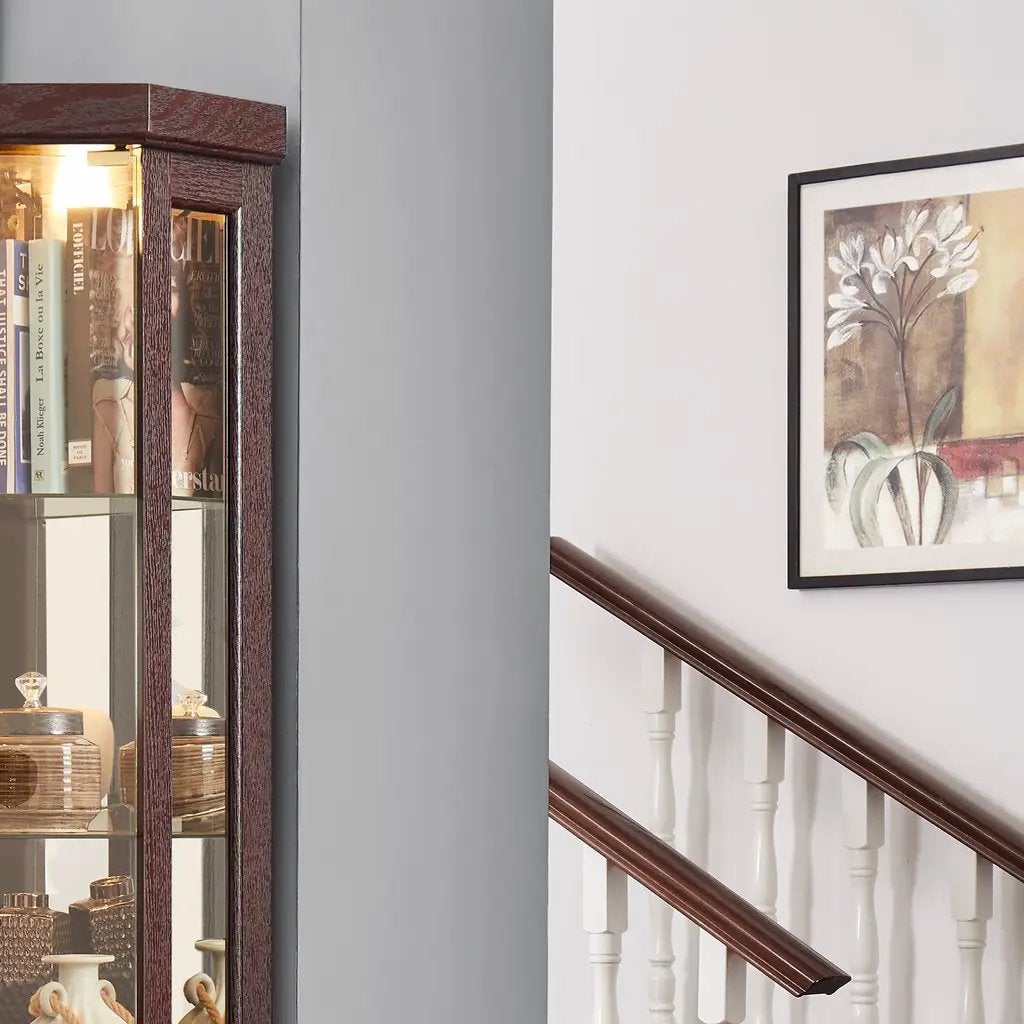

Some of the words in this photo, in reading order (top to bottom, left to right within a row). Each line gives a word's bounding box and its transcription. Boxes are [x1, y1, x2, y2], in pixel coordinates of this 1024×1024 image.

[35, 263, 43, 287] Vie
[36, 290, 43, 302] la
[39, 306, 43, 323] ou
[36, 365, 43, 383] La
[36, 397, 46, 429] Klieger
[37, 431, 45, 457] Noah
